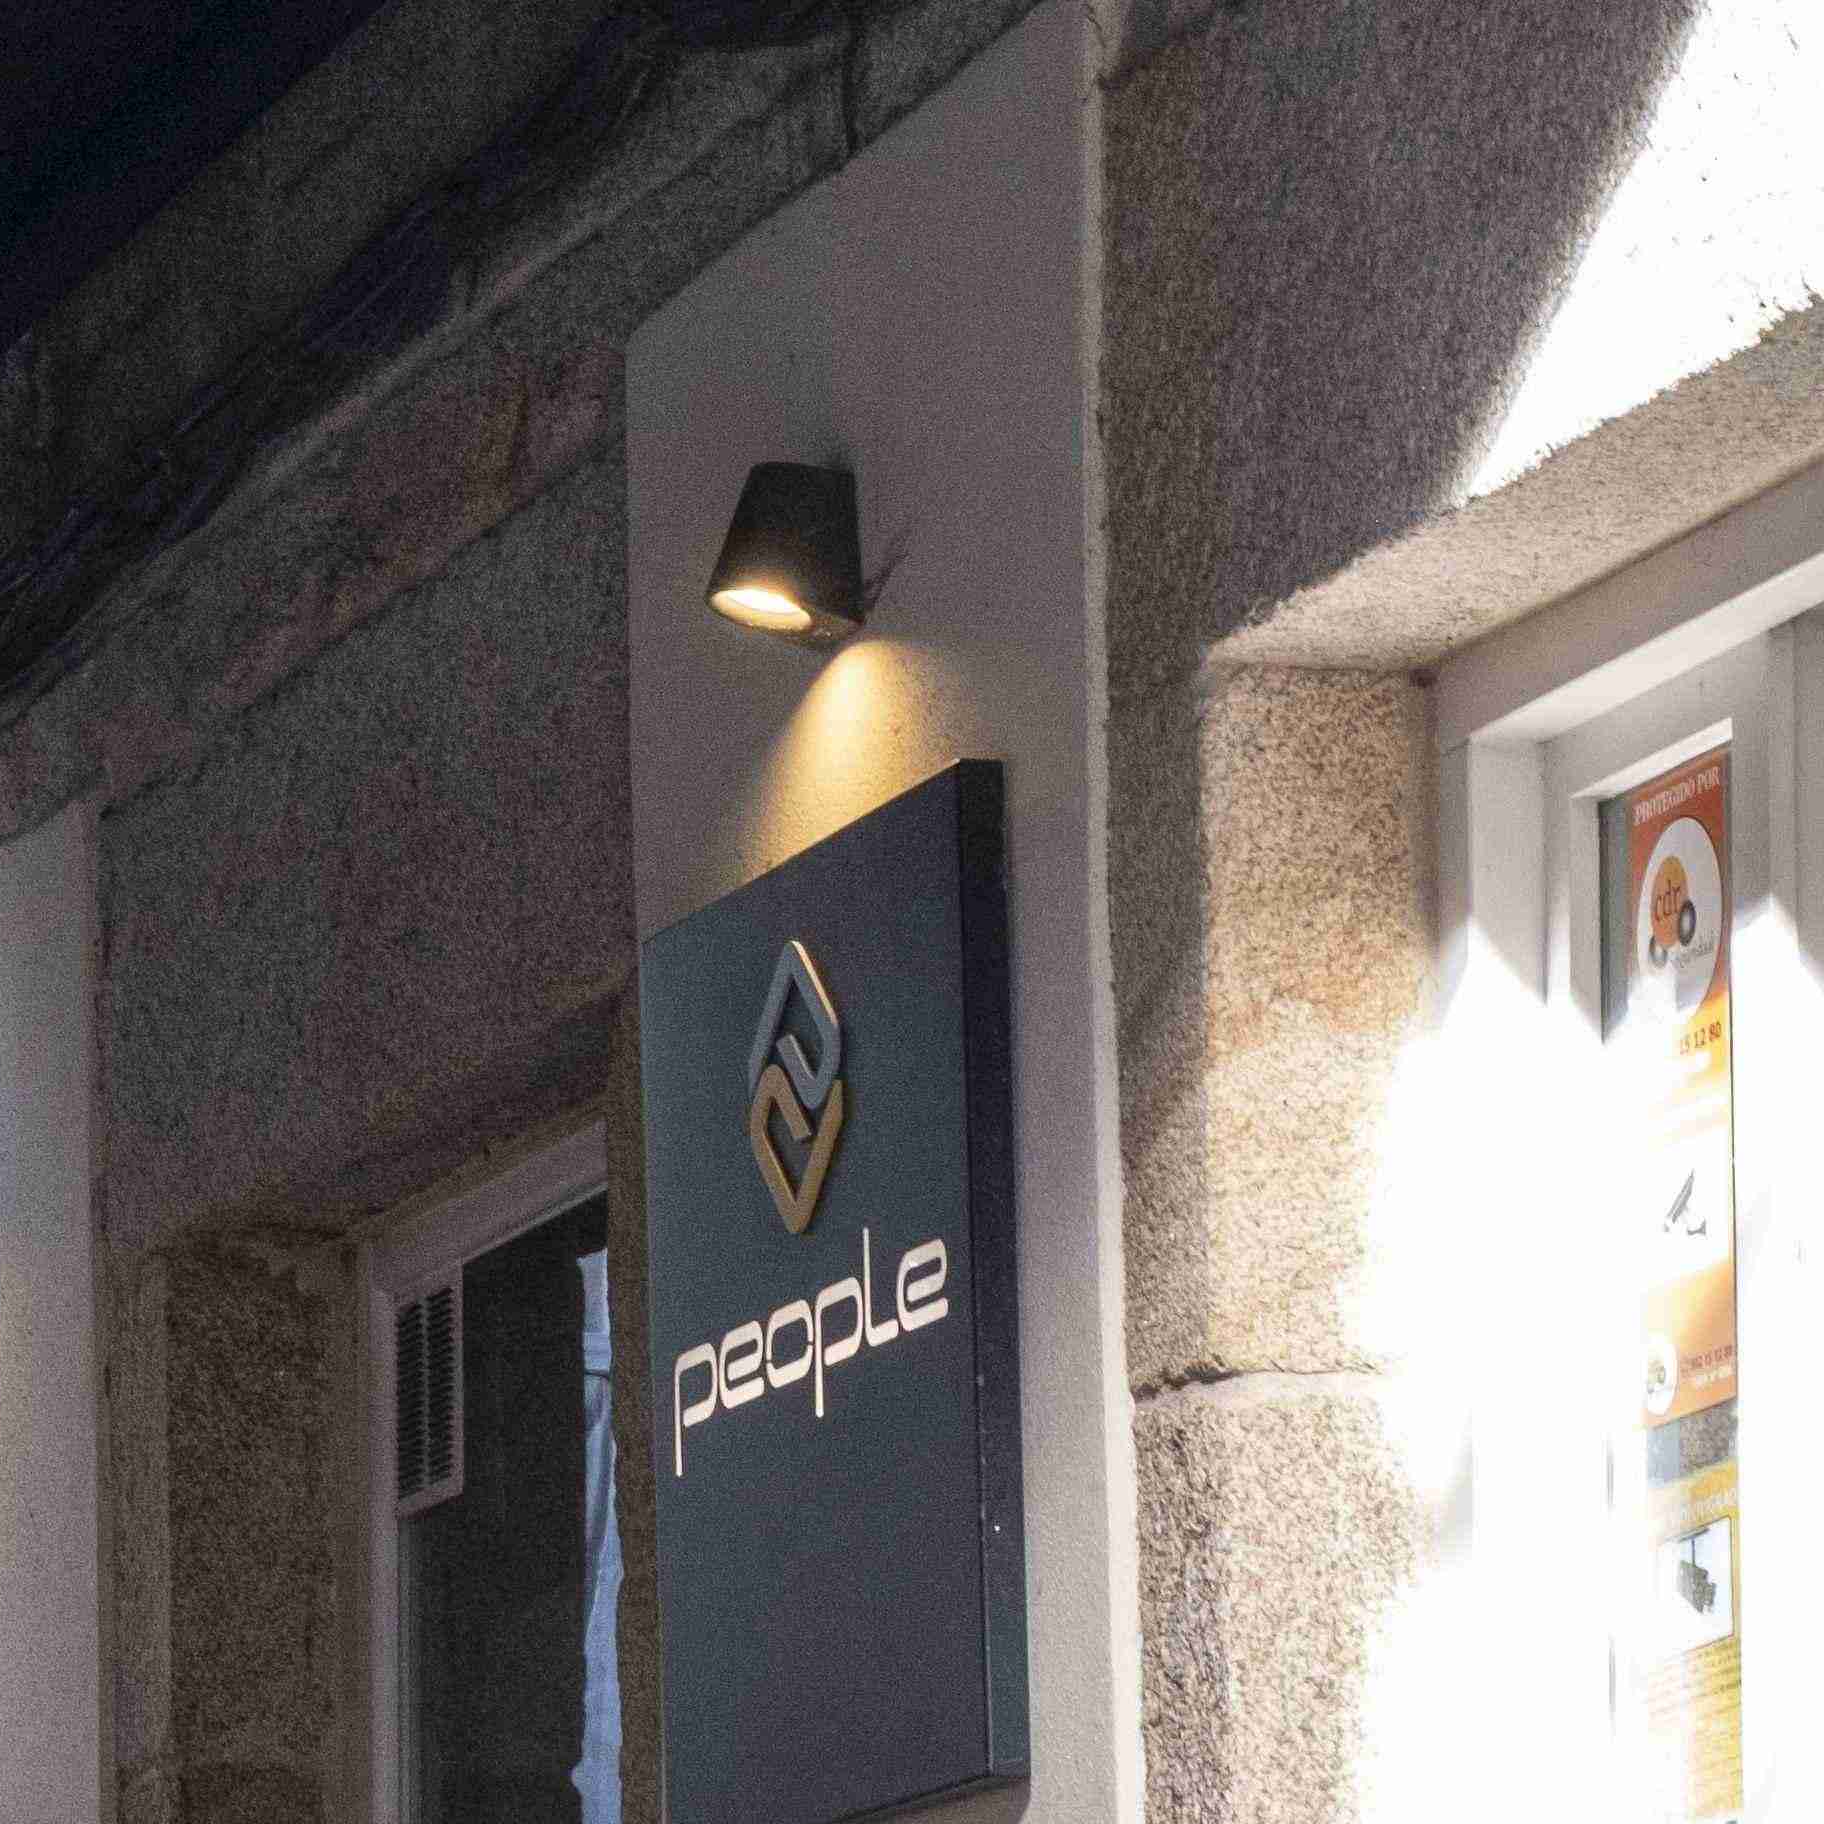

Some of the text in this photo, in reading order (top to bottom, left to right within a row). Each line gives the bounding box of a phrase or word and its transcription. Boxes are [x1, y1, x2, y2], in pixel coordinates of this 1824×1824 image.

[1633, 766, 1721, 825] PROTEGIDO POR
[673, 1227, 950, 1477] people
